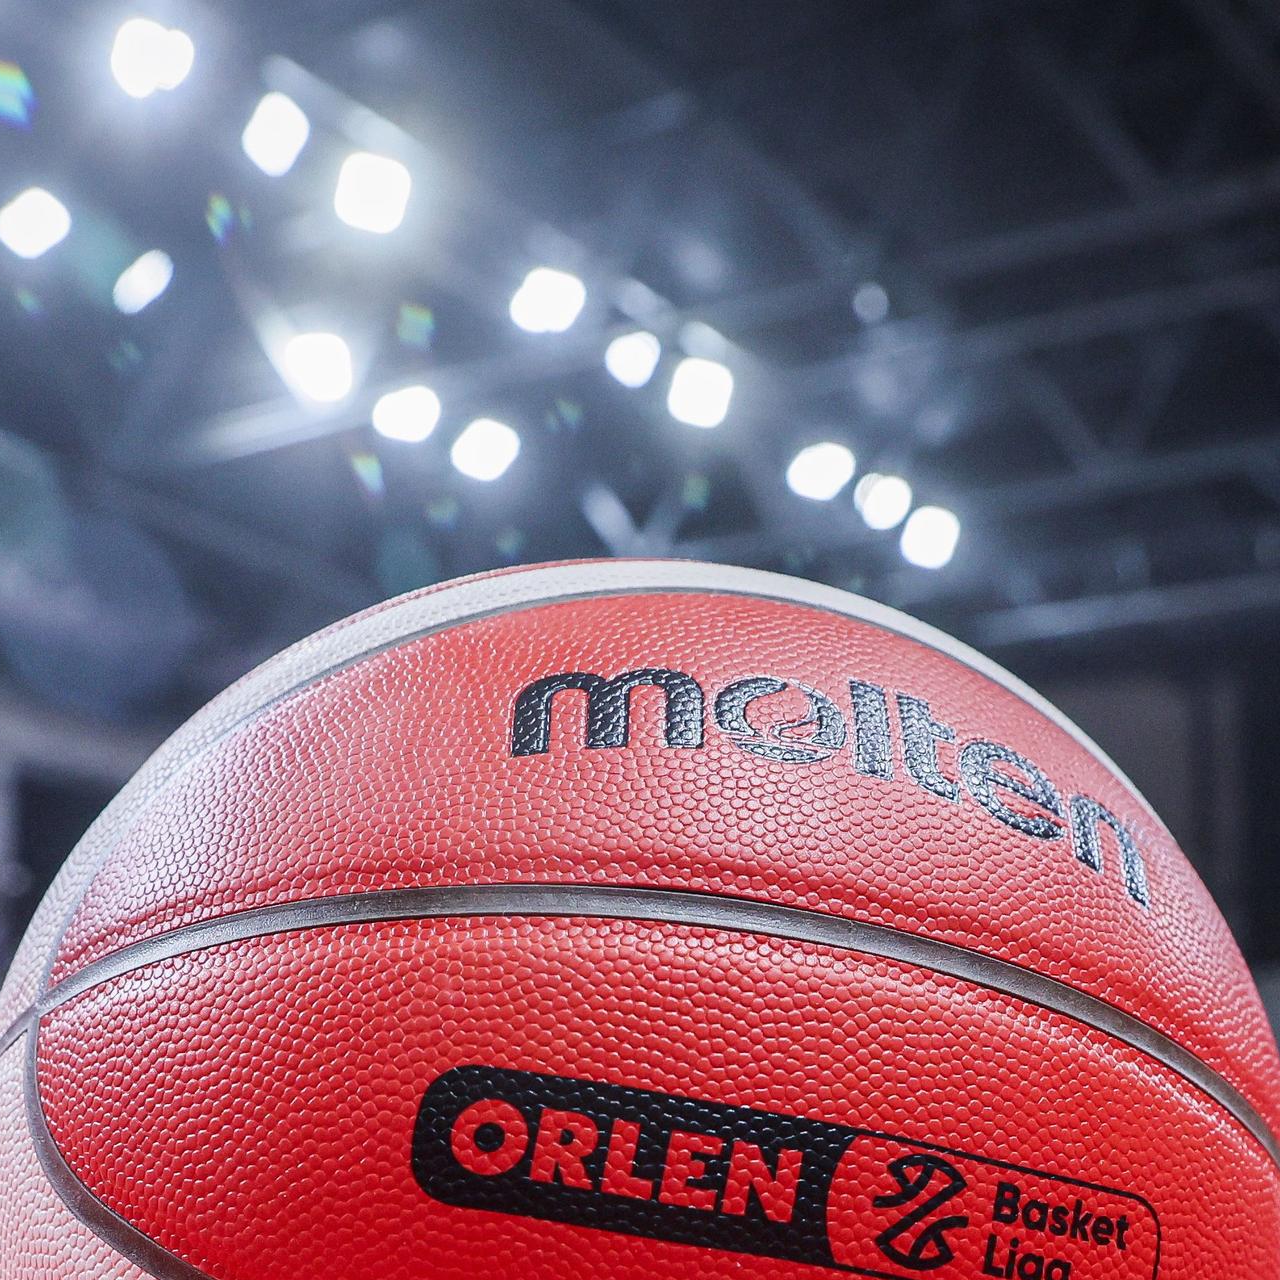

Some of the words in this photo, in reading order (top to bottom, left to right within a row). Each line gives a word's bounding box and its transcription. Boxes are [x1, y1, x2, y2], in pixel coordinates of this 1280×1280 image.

[511, 667, 1150, 909] molten
[450, 1098, 806, 1223] ORLEN
[992, 1181, 1129, 1250] Basket
